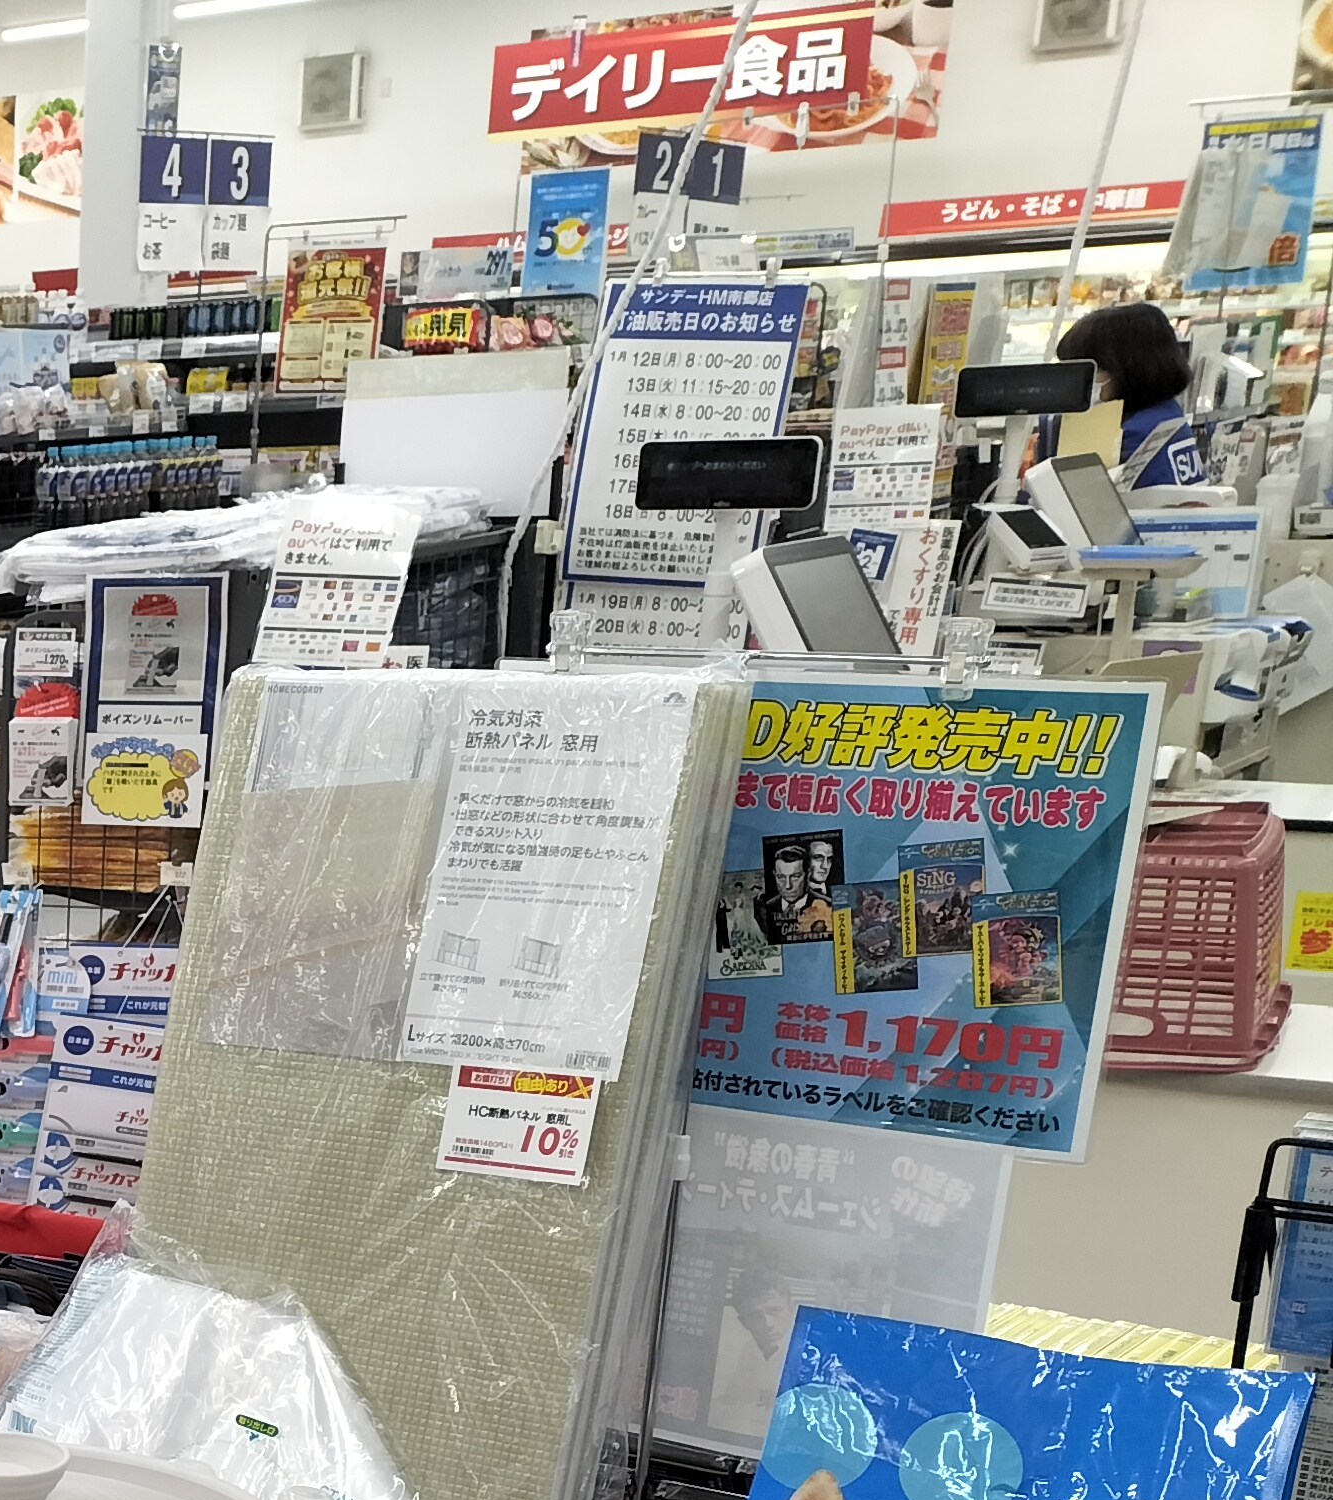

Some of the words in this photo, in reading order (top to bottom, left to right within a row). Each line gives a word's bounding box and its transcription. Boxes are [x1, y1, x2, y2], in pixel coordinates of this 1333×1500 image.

[511, 31, 847, 121] デイリー食品
[162, 143, 182, 197] 4
[230, 146, 249, 200] 3
[652, 141, 671, 190] 2
[710, 148, 725, 197] 1
[143, 213, 176, 230] コーヒー
[641, 290, 774, 306] サンデーHM南郷店
[900, 528, 940, 645] おくすり専用
[102, 714, 193, 725] ポイズンリムーバー
[469, 709, 543, 728] 冷気対策
[466, 732, 552, 750] 断熱パネル
[560, 735, 598, 752] 窓用
[735, 772, 1105, 828] まで幅広く取り揃えています
[454, 826, 543, 840] できるスリット入り
[447, 858, 523, 872] まわりでも活躍
[917, 872, 956, 889] SING
[48, 971, 77, 984] mini
[777, 1002, 830, 1023] 本体
[775, 1022, 828, 1044] 価格
[837, 1009, 1064, 1070] 1,170円
[515, 1076, 569, 1093] 理由あり
[468, 1105, 541, 1121] HC断熱パネル
[520, 1125, 579, 1155] 10%
